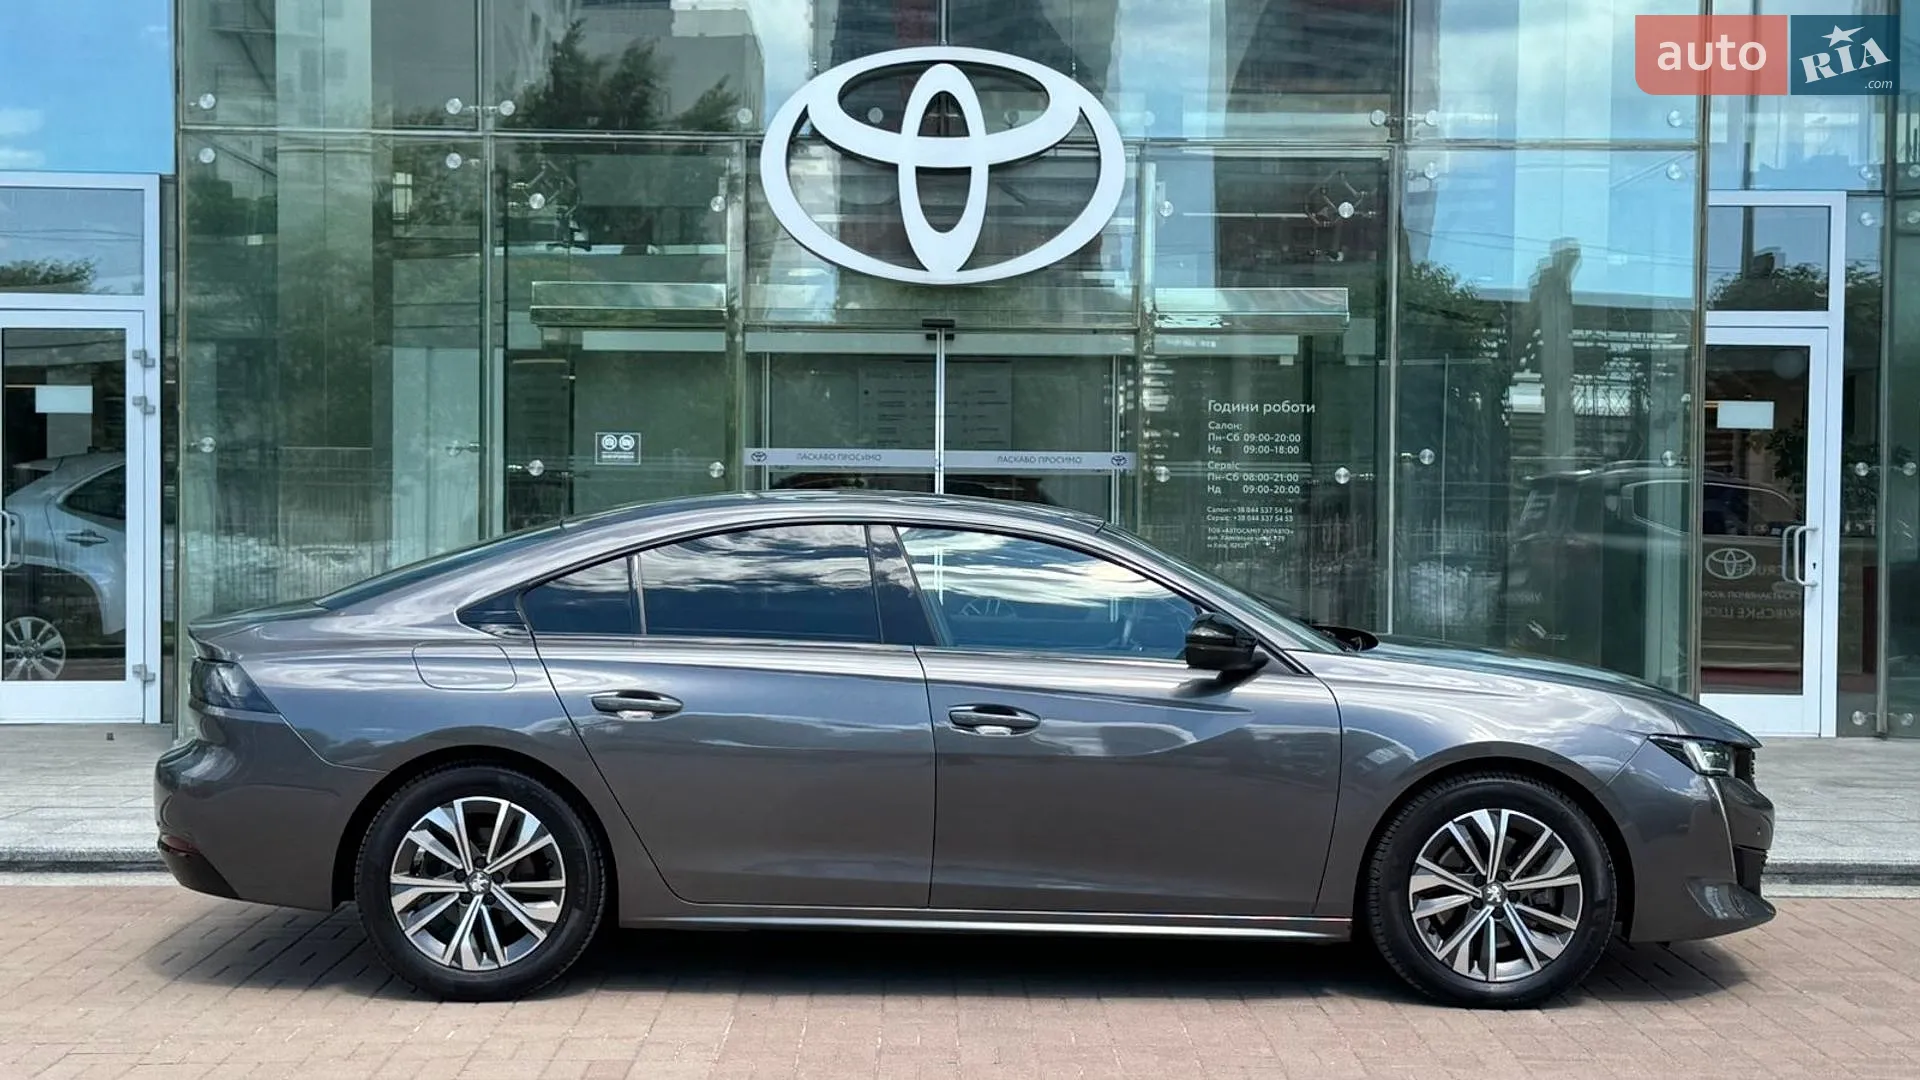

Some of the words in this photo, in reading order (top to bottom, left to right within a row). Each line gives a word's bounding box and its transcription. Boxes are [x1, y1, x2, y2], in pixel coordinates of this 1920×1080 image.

[1207, 400, 1259, 414] Години
[1263, 400, 1316, 416] роботи
[1208, 421, 1242, 430] Салон:
[1208, 433, 1240, 442] Пн-Сб
[1243, 433, 1301, 442] 09:00-20:00
[1208, 445, 1222, 455] Нд
[1243, 445, 1300, 454] 09:00-18:00
[1207, 473, 1239, 482] Пн-Сб
[1242, 473, 1299, 482] 08:00-21:00
[1207, 485, 1221, 494] Нд
[1243, 485, 1300, 494] 09:00-20:00
